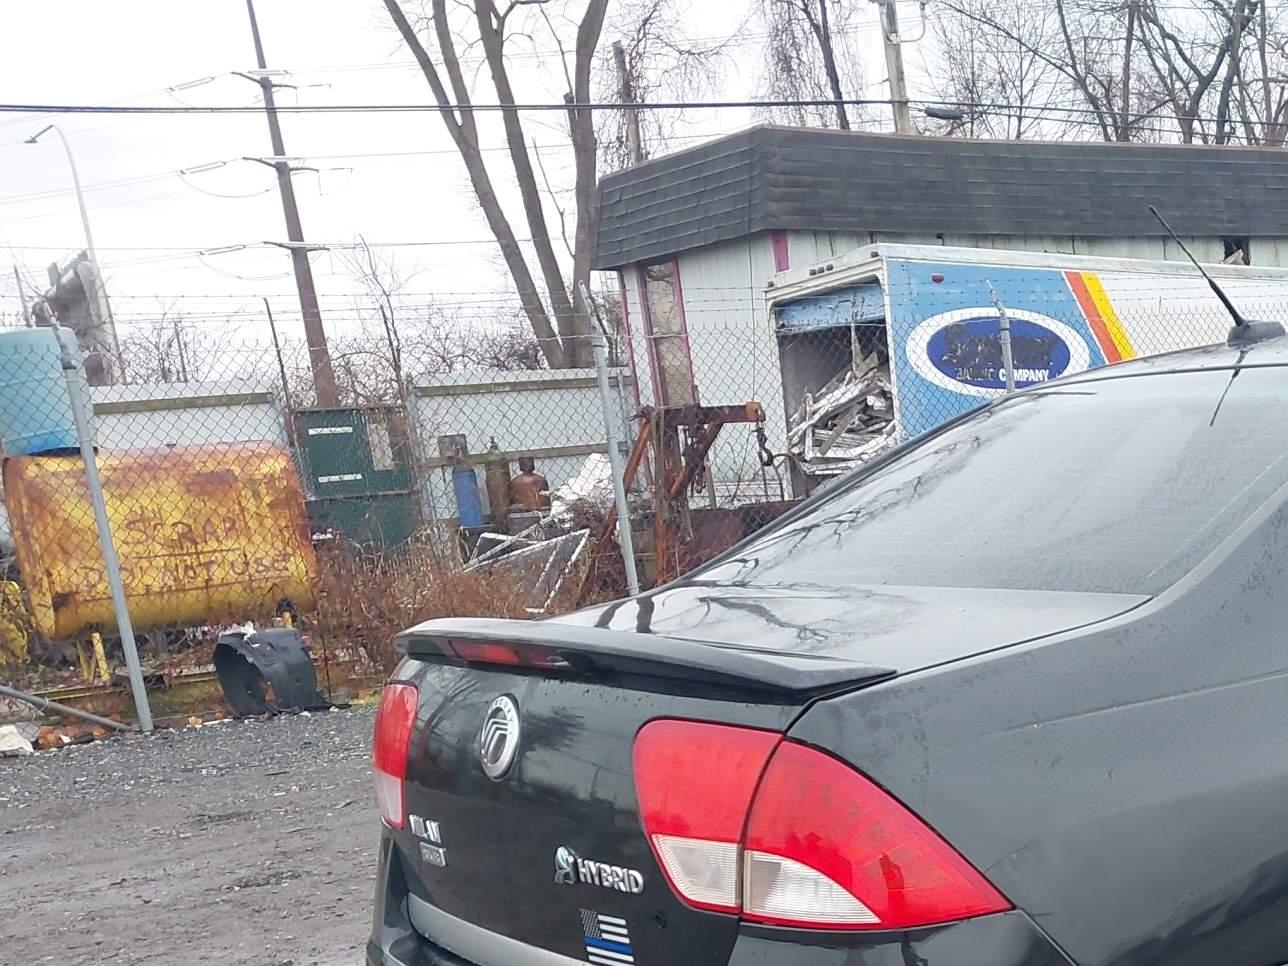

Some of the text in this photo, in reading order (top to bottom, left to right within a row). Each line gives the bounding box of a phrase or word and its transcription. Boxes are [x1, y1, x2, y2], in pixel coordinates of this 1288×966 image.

[998, 368, 1049, 382] CMPANY
[161, 560, 217, 590] NOT
[231, 552, 288, 576] USE
[577, 858, 644, 893] HYBRID
